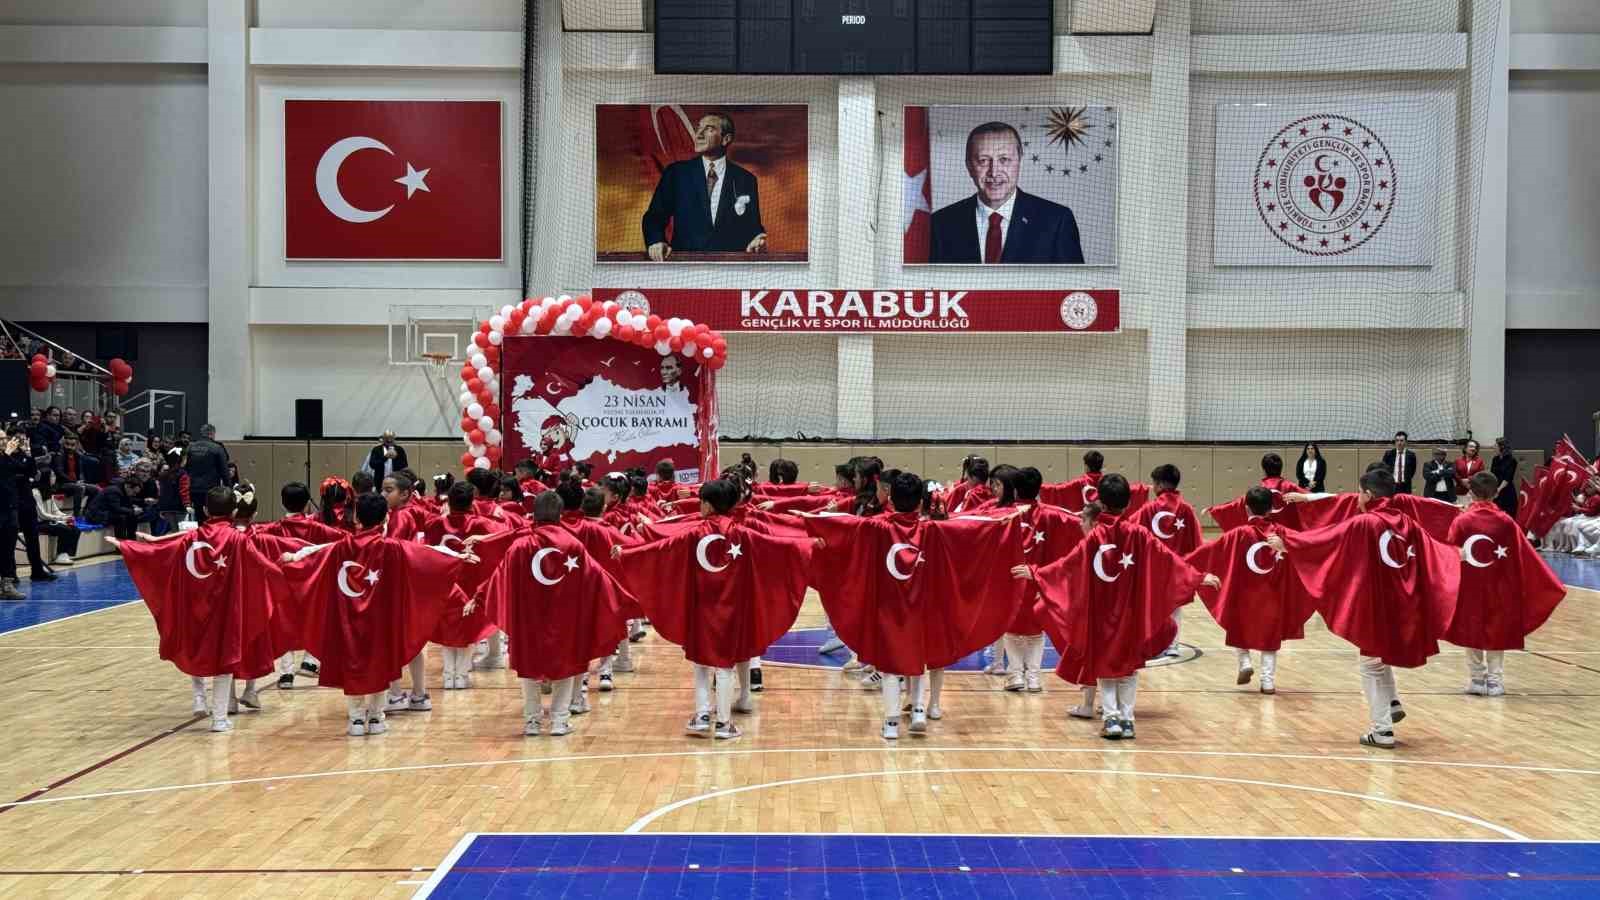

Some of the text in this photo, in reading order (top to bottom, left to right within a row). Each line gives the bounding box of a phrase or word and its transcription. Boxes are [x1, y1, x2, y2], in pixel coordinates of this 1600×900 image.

[841, 15, 866, 25] PERIOD
[1351, 151, 1362, 162] VE
[1358, 162, 1371, 185] SPOR
[740, 290, 969, 317] KARABÜK
[741, 317, 970, 330] GENÇLİK VE SPOR İL MÜDÜRLÜĞÜ
[604, 394, 666, 408] 23 NİSAN
[582, 416, 688, 430] ÇOCUK BAYRAMI
